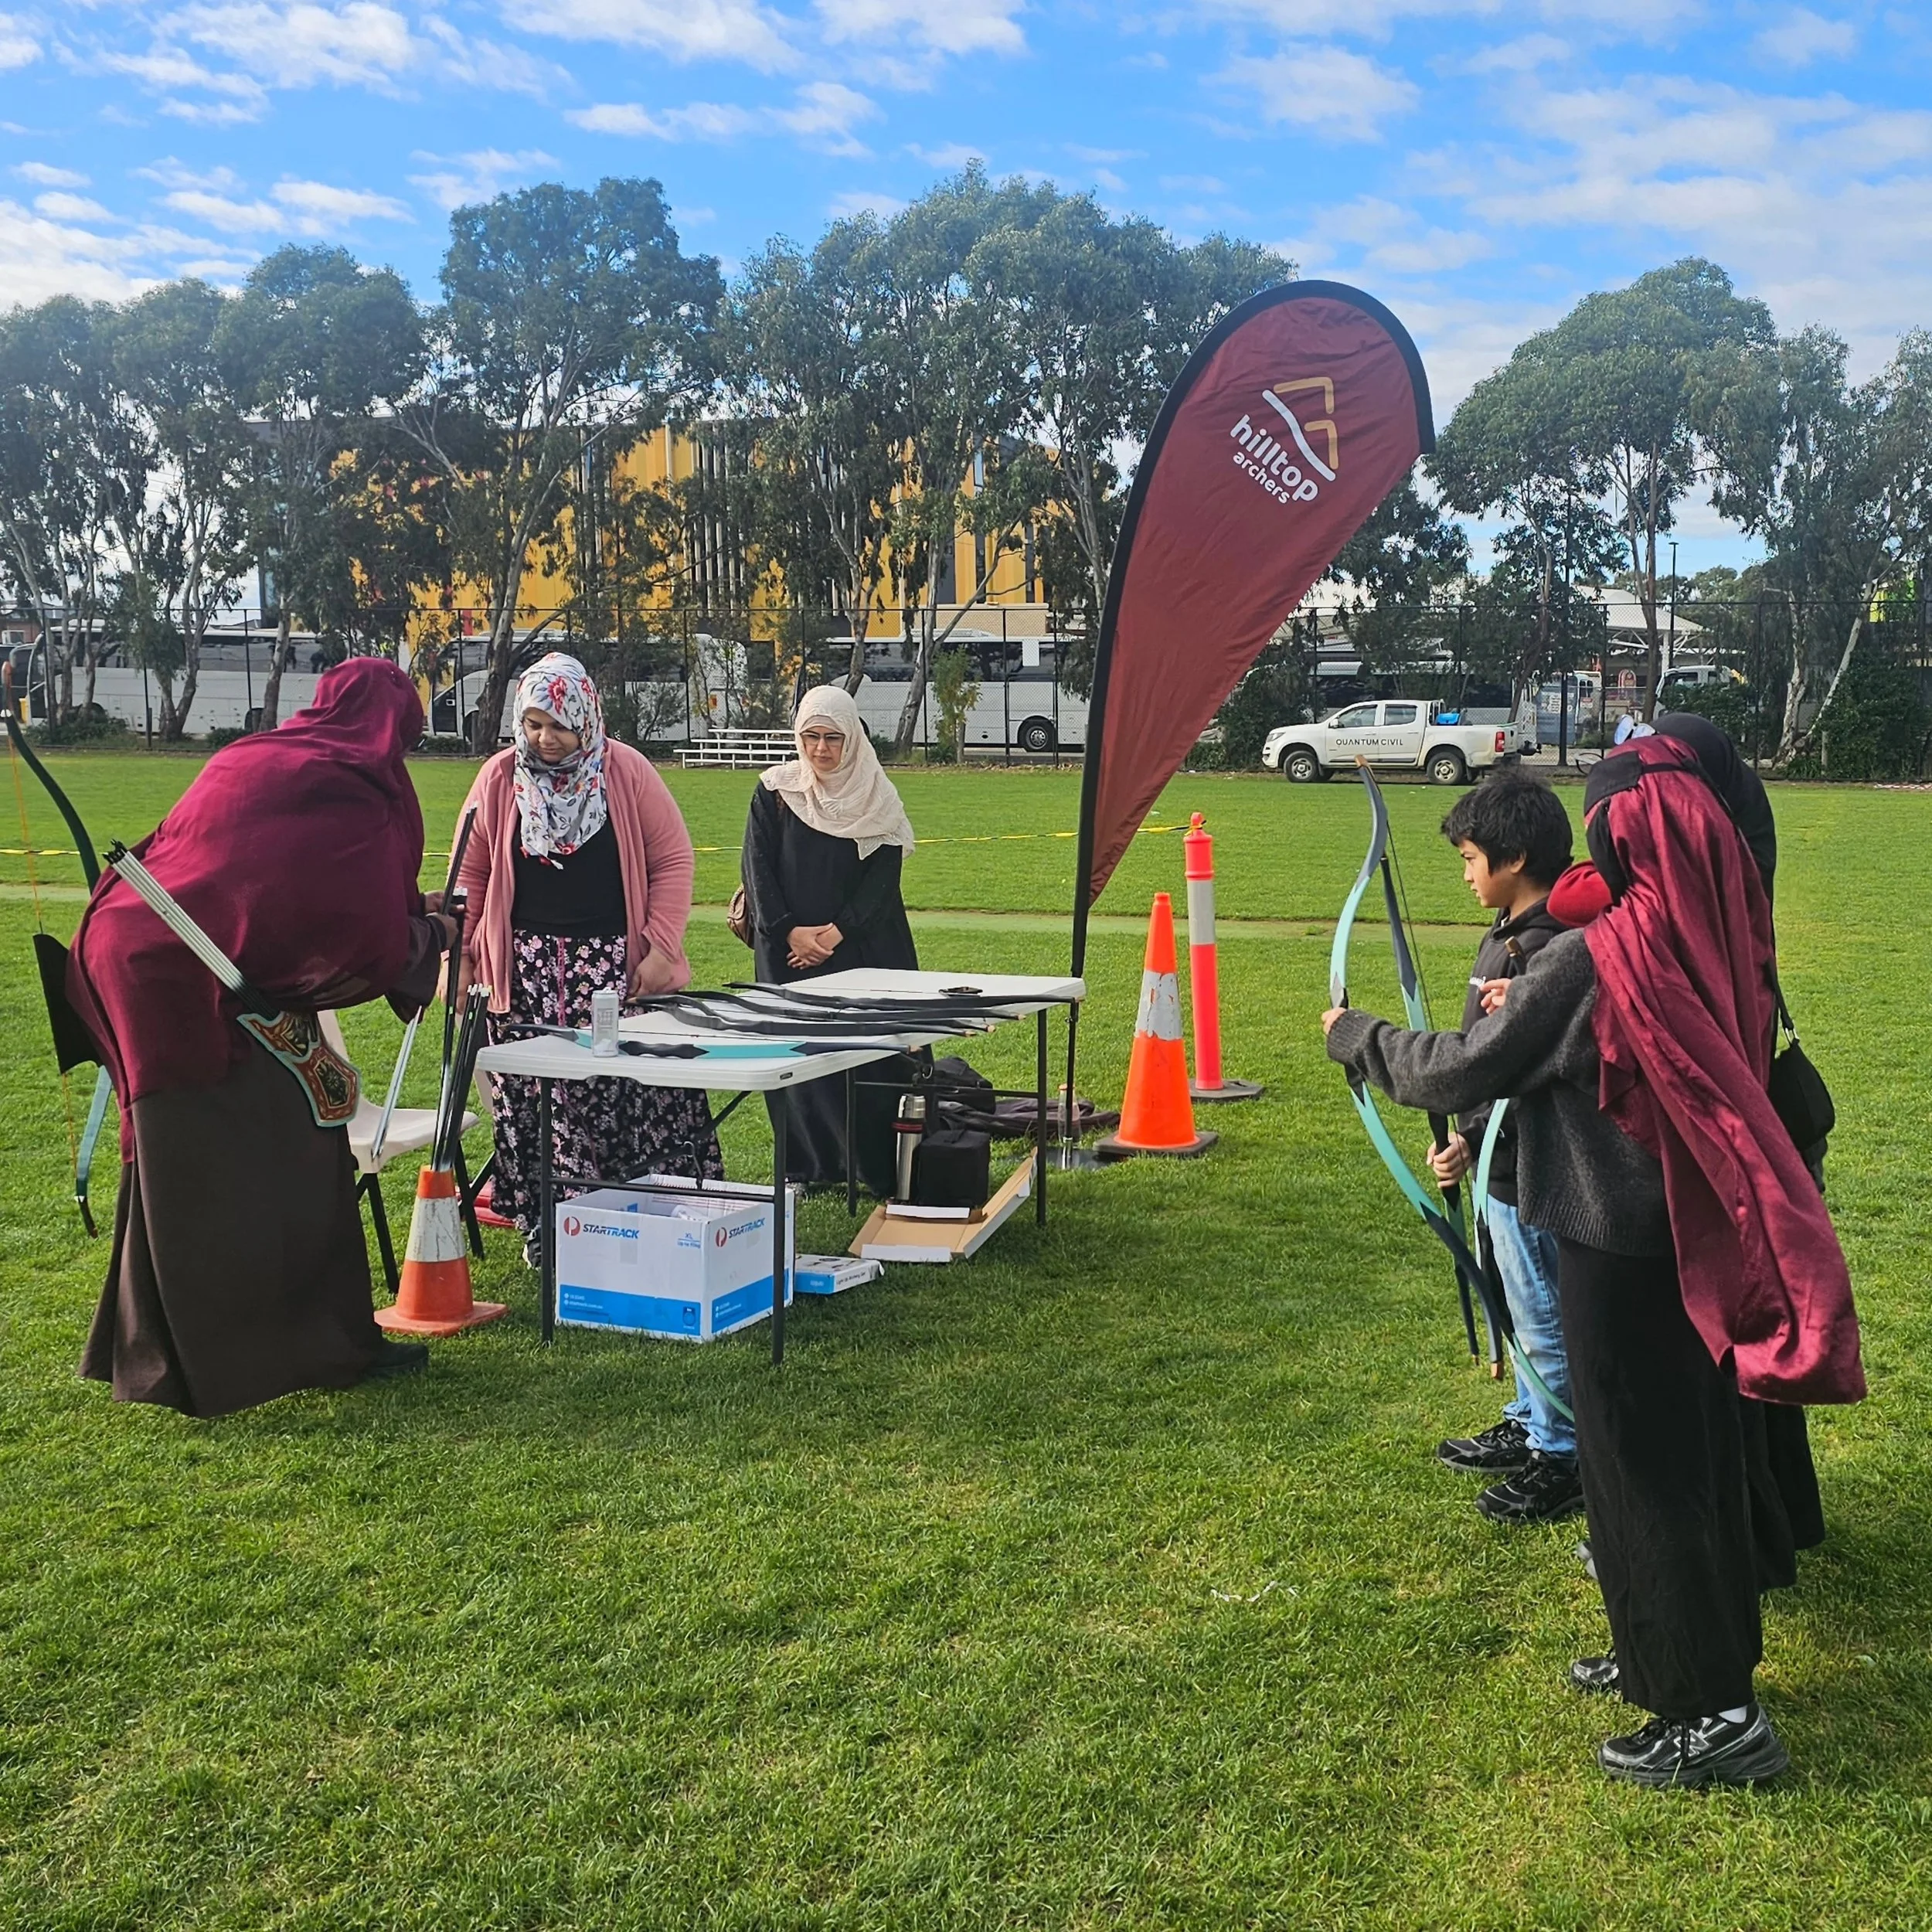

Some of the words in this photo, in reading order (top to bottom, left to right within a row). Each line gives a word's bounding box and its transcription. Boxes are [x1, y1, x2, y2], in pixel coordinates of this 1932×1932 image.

[1230, 413, 1318, 502] hilltop
[1233, 451, 1291, 504] archers
[583, 1223, 640, 1240] STARTRACK
[728, 1217, 766, 1239] STARTRACK
